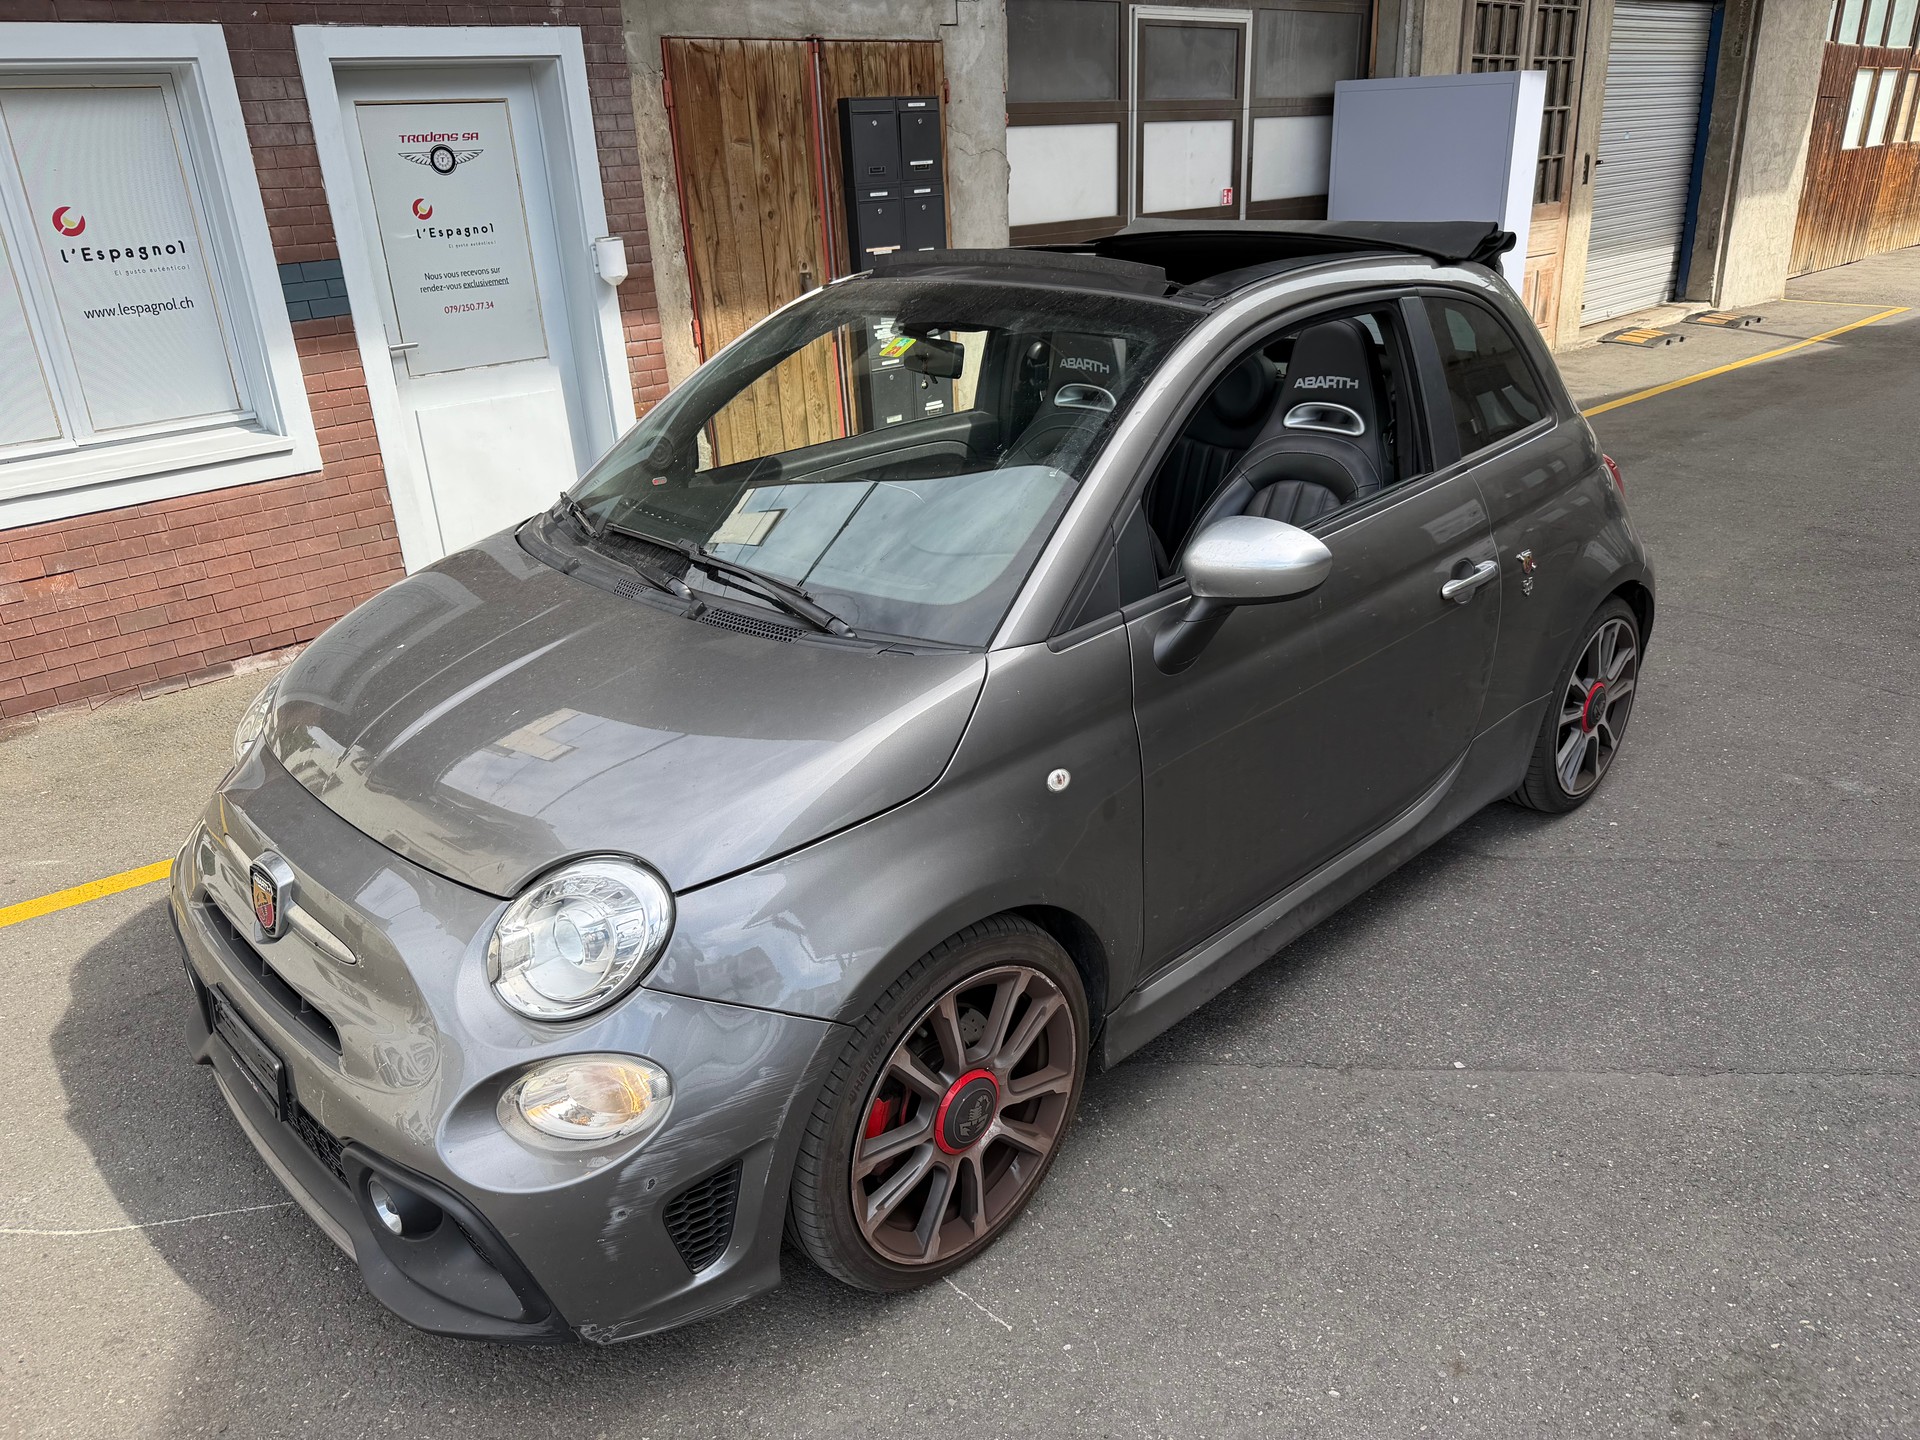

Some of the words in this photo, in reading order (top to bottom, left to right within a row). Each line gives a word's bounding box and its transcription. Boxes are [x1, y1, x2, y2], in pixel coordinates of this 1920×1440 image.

[462, 131, 479, 141] SA
[416, 223, 494, 239] l'Espagnol
[60, 240, 186, 263] l'Espagnol
[125, 268, 147, 277] gusto
[424, 272, 443, 281] Nous
[443, 271, 460, 279] vous
[460, 268, 490, 277] recevons
[420, 283, 462, 293] rendez-vous
[463, 277, 510, 289] exclusivement
[83, 296, 195, 319] www.lespagnol.ch
[444, 301, 494, 314] 079/250.77.34
[1059, 358, 1110, 374] ABARTH
[1293, 375, 1359, 389] ABARTH
